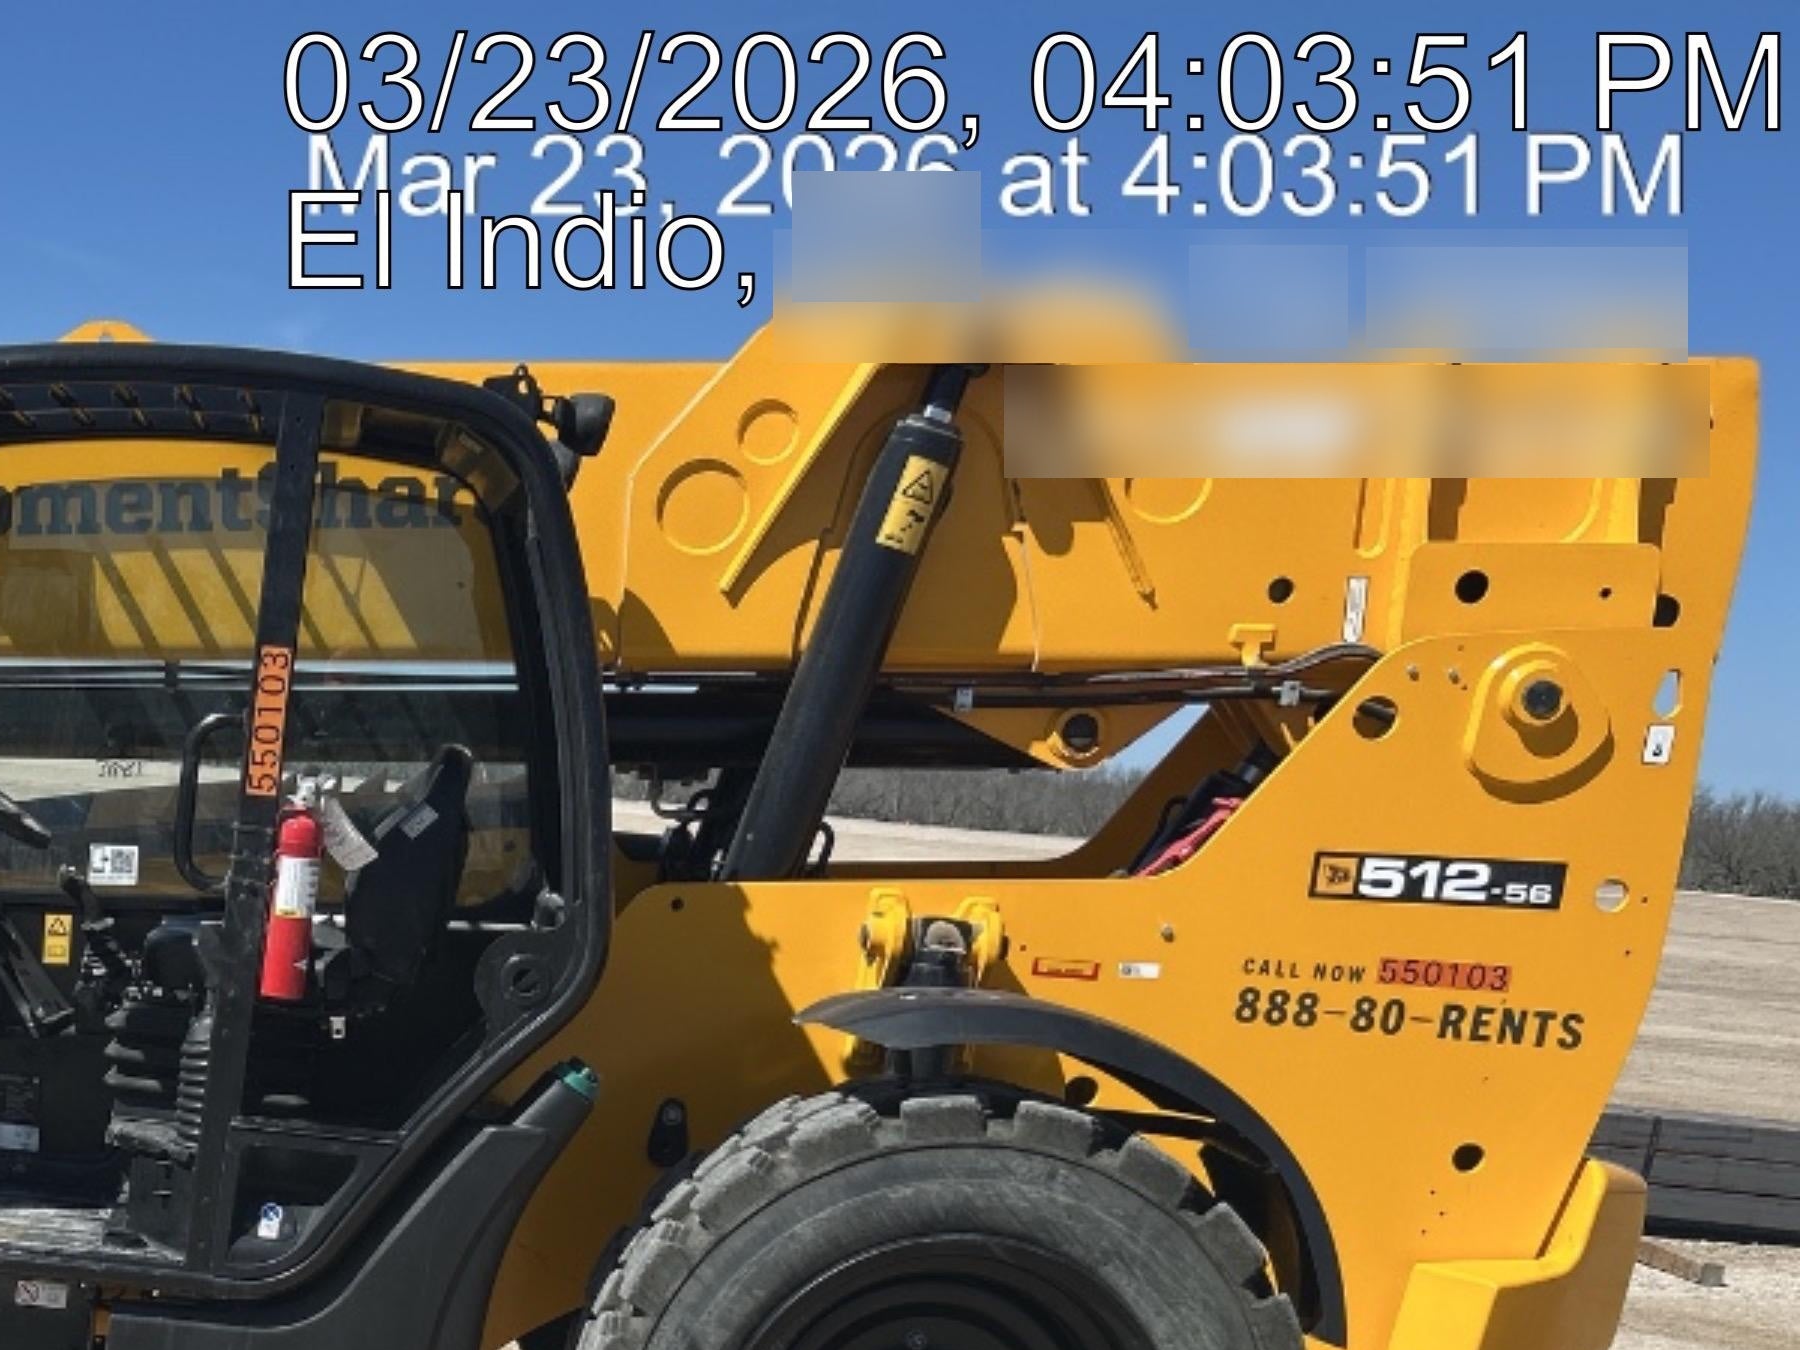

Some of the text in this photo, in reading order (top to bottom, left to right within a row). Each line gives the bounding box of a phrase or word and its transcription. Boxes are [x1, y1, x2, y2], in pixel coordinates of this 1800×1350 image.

[251, 651, 289, 792] 550103
[1358, 857, 1553, 905] 512-56
[1242, 957, 1366, 983] CALL NOW
[1378, 957, 1509, 991] 550103
[1234, 986, 1585, 1050] 888-80-RENTS
